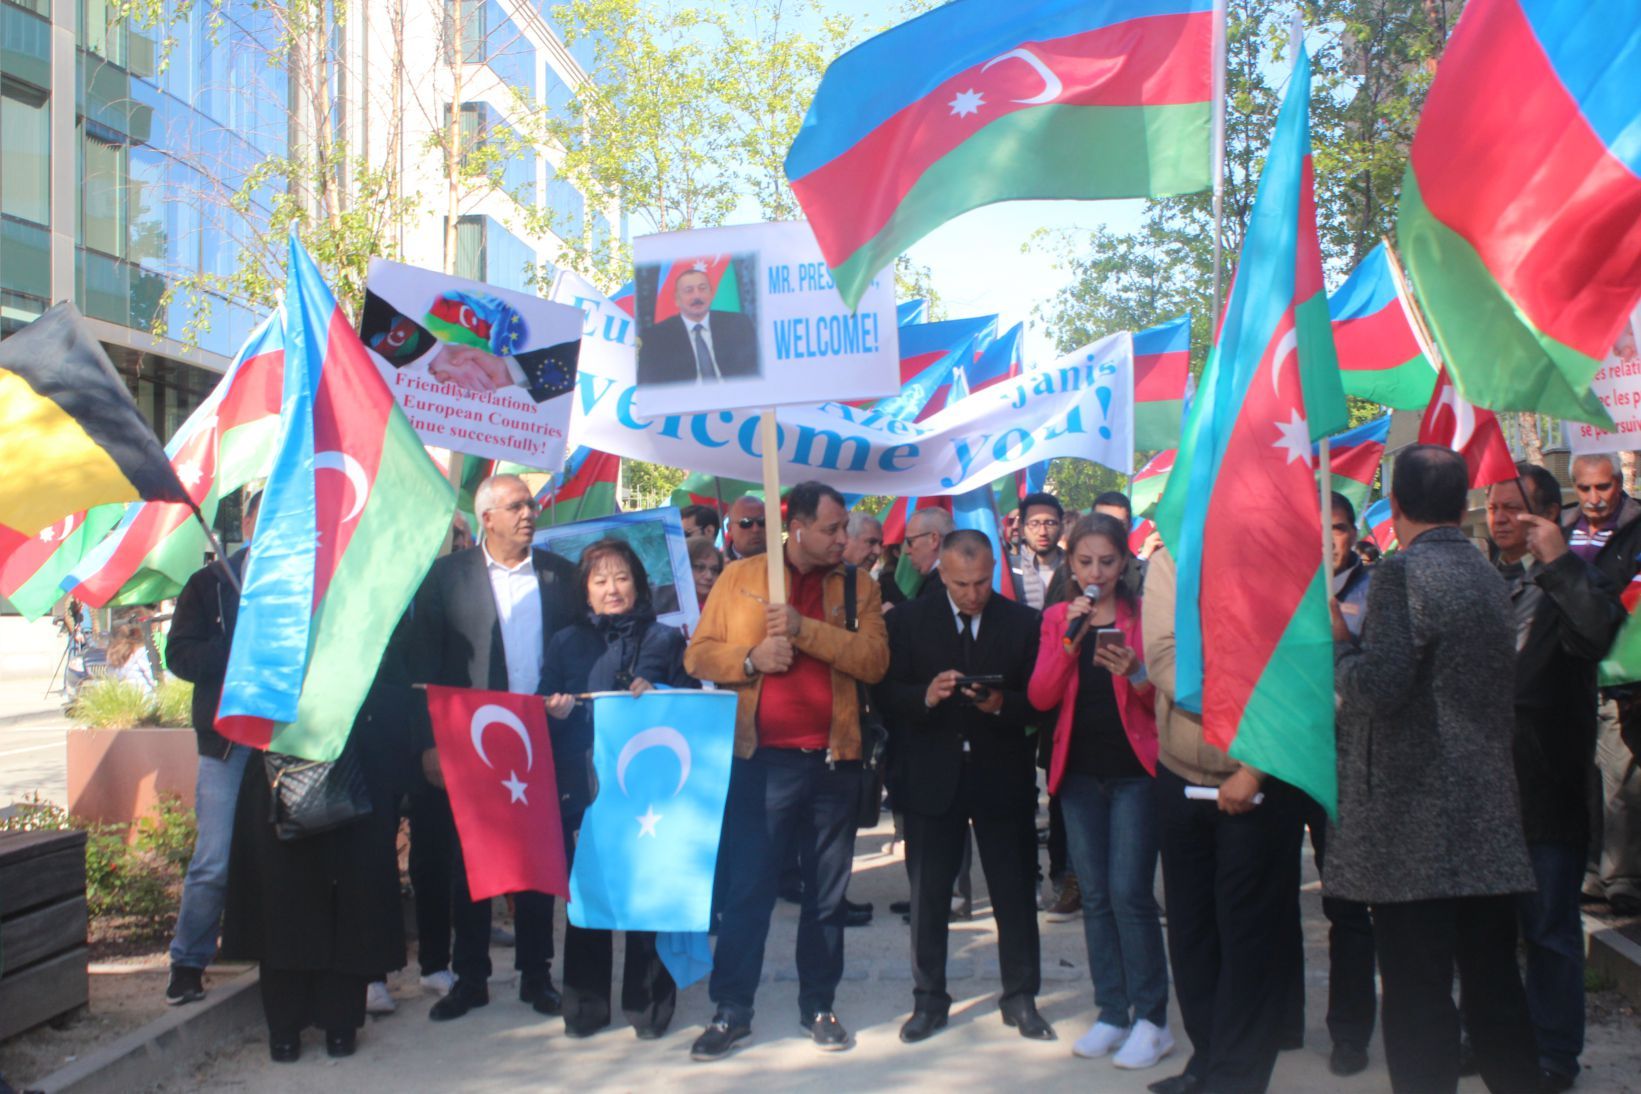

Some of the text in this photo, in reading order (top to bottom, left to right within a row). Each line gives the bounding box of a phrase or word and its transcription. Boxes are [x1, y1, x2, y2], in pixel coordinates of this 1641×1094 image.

[768, 264, 795, 294] MR.
[773, 312, 879, 360] WELCOME!
[396, 372, 538, 414] Friendly relations
[1613, 388, 1630, 406] les
[404, 394, 563, 438] European Countries
[450, 425, 546, 455] successfully!
